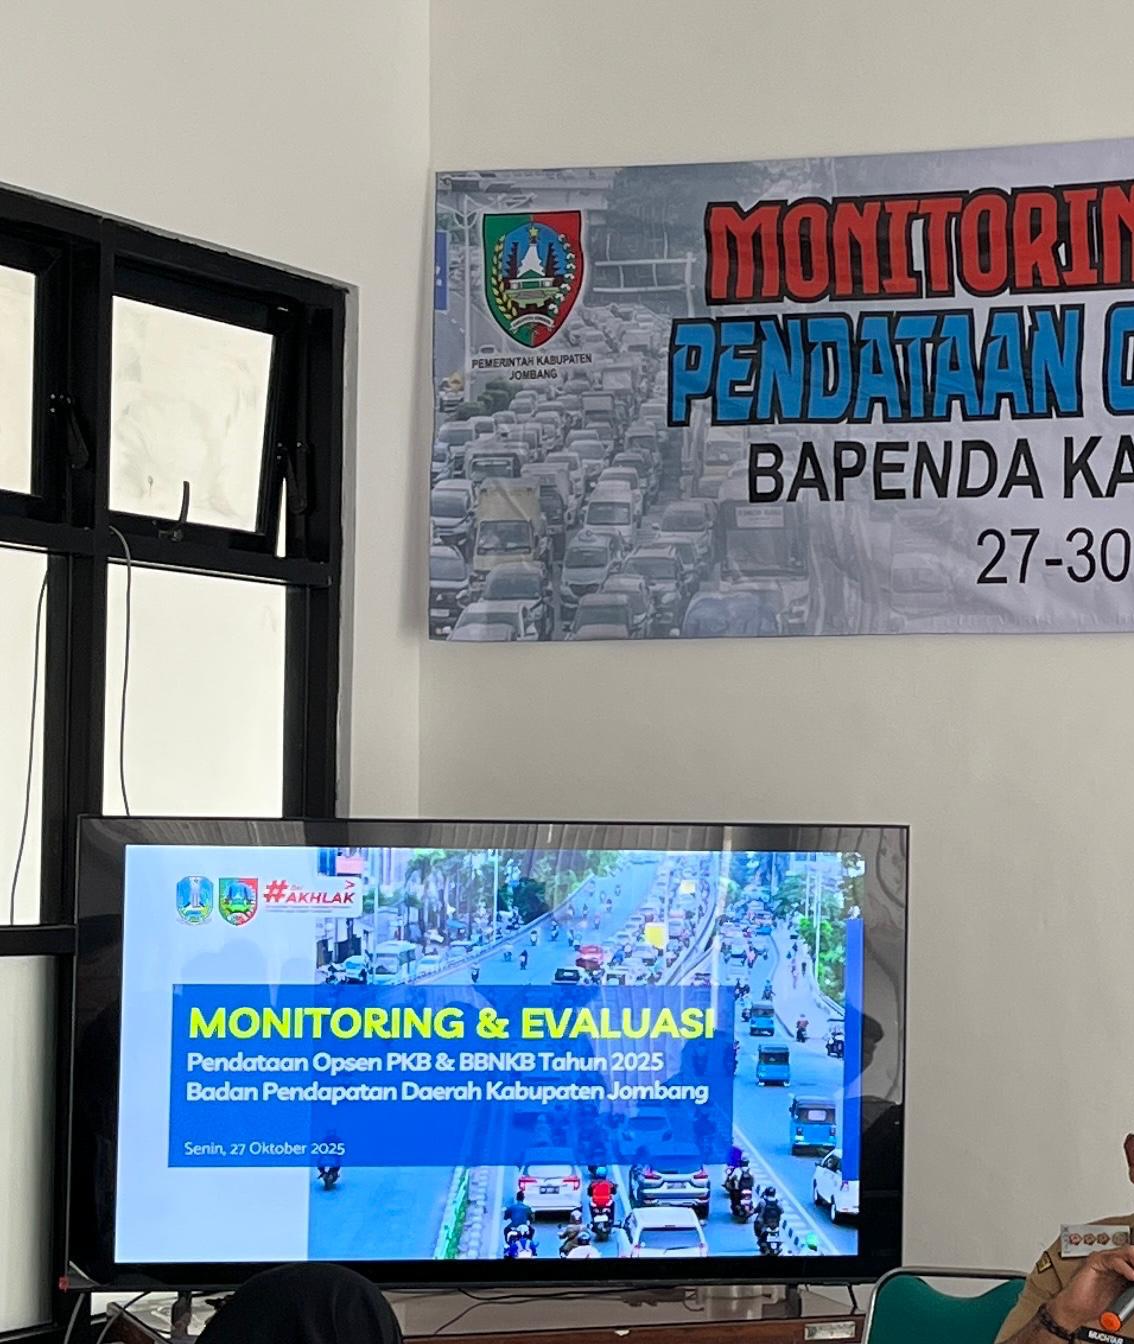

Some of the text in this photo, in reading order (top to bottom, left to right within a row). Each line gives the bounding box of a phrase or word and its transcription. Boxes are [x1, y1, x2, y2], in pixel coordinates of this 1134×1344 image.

[472, 354, 592, 369] PEMERINTAH KABUPATEN
[509, 368, 557, 380] JOMBANG
[667, 304, 1085, 427] PENDATAAN
[747, 438, 1043, 503] BAPENDA
[976, 528, 1131, 584] 27-30
[189, 1007, 715, 1039] MONITORING & EVALUASI
[187, 1052, 665, 1076] Pendataan Opsen PKB & BBNKB Tahun 2025
[186, 1080, 709, 1105] Badan Pendapatan Daerah Kabupaten Jombang
[184, 1141, 345, 1156] Senin, 27 Oktober 2025
